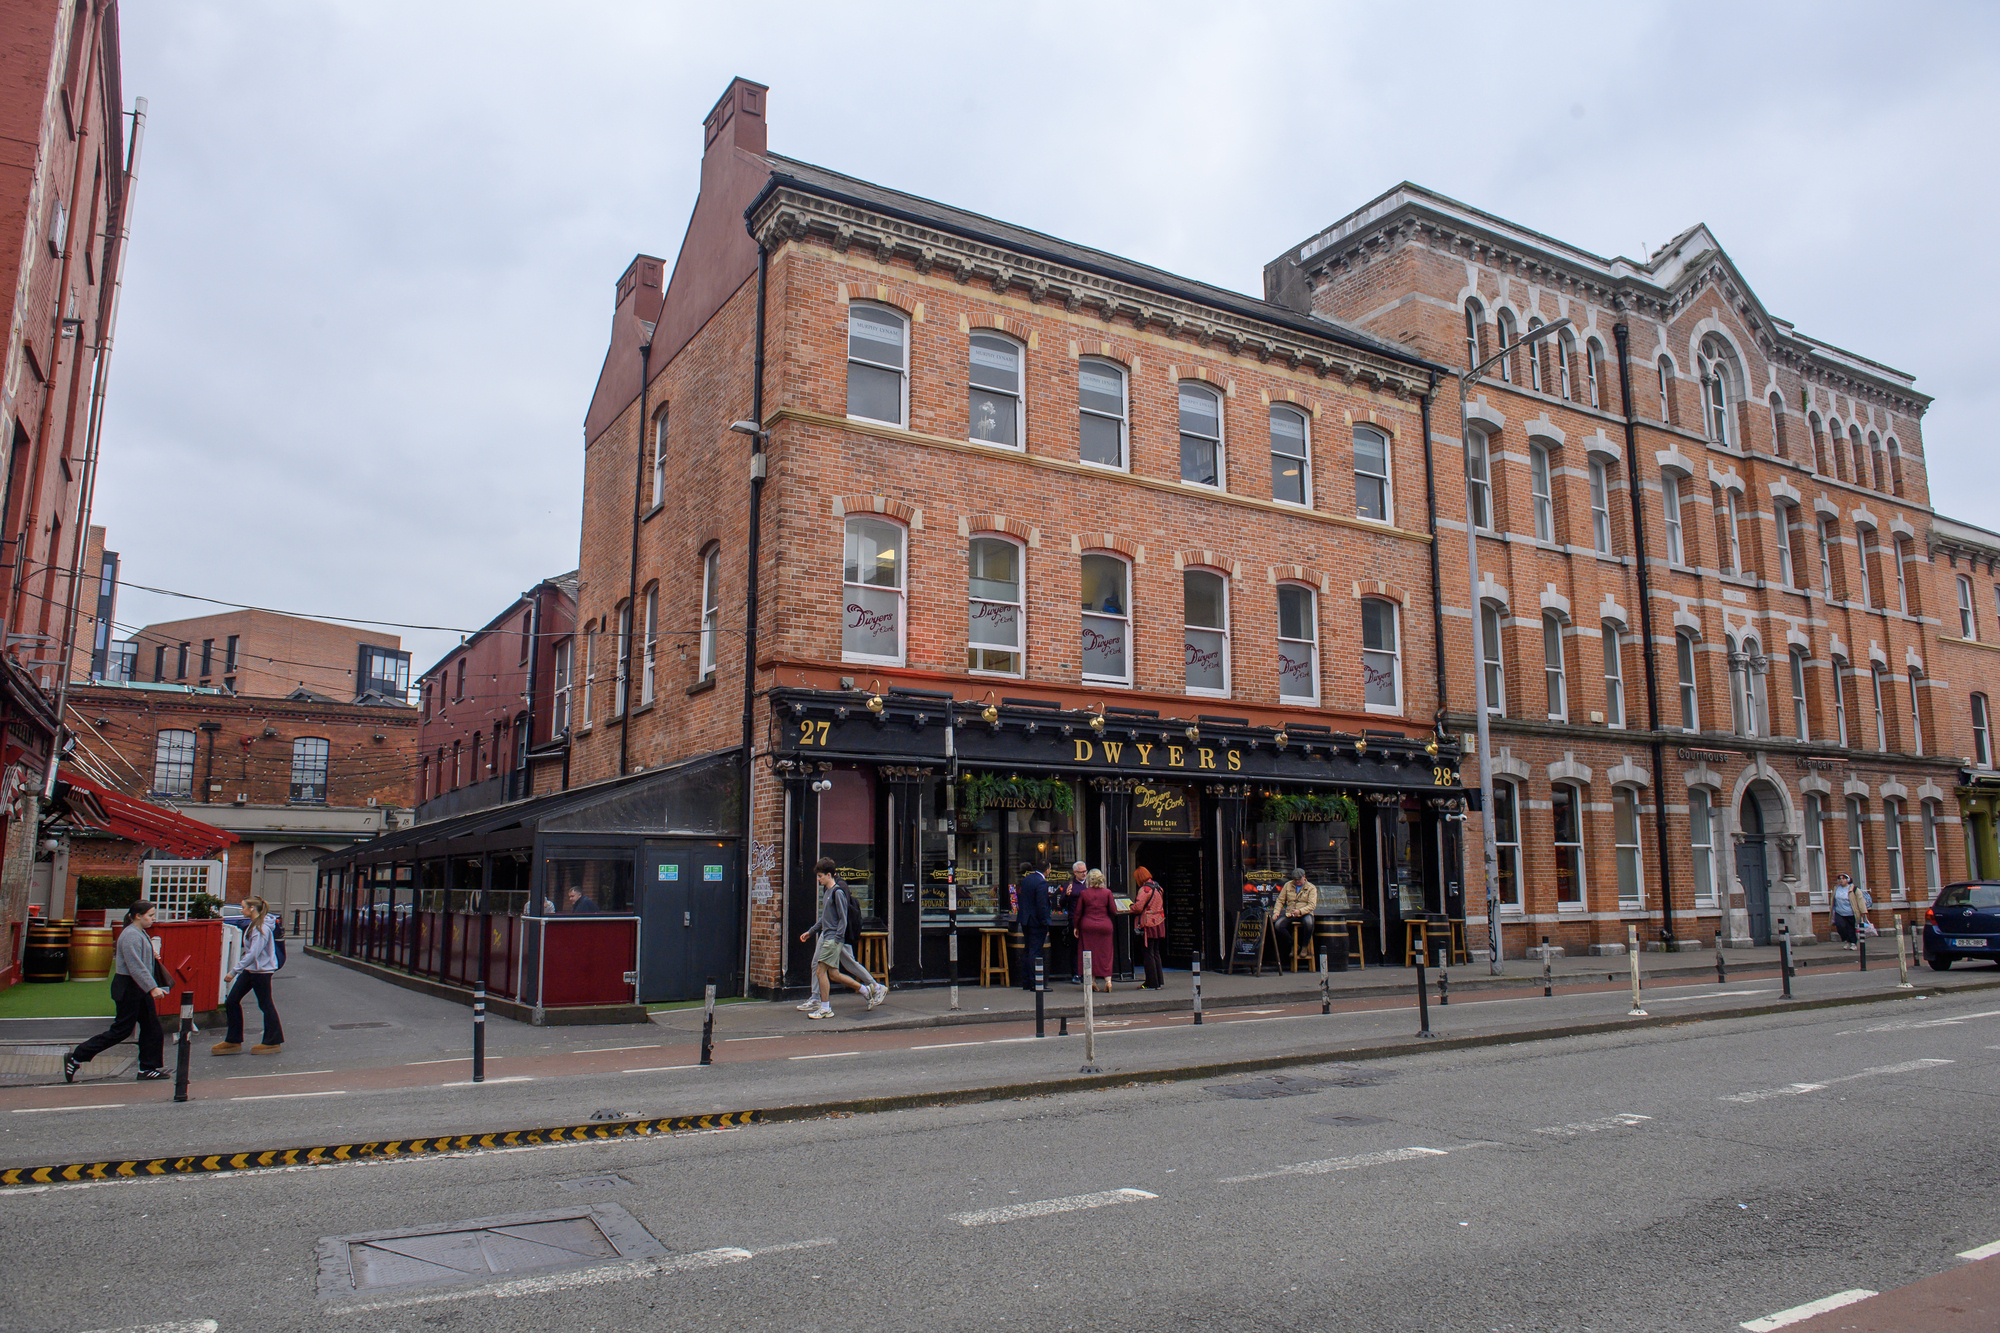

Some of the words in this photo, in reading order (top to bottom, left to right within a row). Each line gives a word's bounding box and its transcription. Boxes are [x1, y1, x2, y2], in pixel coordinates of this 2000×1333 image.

[857, 322, 878, 332] MURPHY
[879, 327, 898, 336] LYNAM
[976, 350, 995, 358] MURPHY
[996, 354, 1014, 362] LYNAM
[847, 603, 893, 631] Dwyers
[970, 596, 1012, 621] Dwyers
[873, 628, 879, 637] of
[880, 624, 895, 633] Cork
[1082, 628, 1120, 653] Dwyers
[1185, 644, 1218, 666] Dwyers
[1278, 654, 1309, 676] Dwyers
[1364, 664, 1392, 686] Dwyers
[800, 720, 831, 746] 27
[1074, 739, 1242, 771] DWYERS
[1678, 748, 1729, 763] Courthouse
[1796, 757, 1834, 770] Chambers
[1433, 767, 1452, 787] 28
[1028, 798, 1037, 809] &
[1134, 785, 1171, 810] Dwyers
[1156, 802, 1165, 818] of
[1165, 795, 1186, 811] Cork
